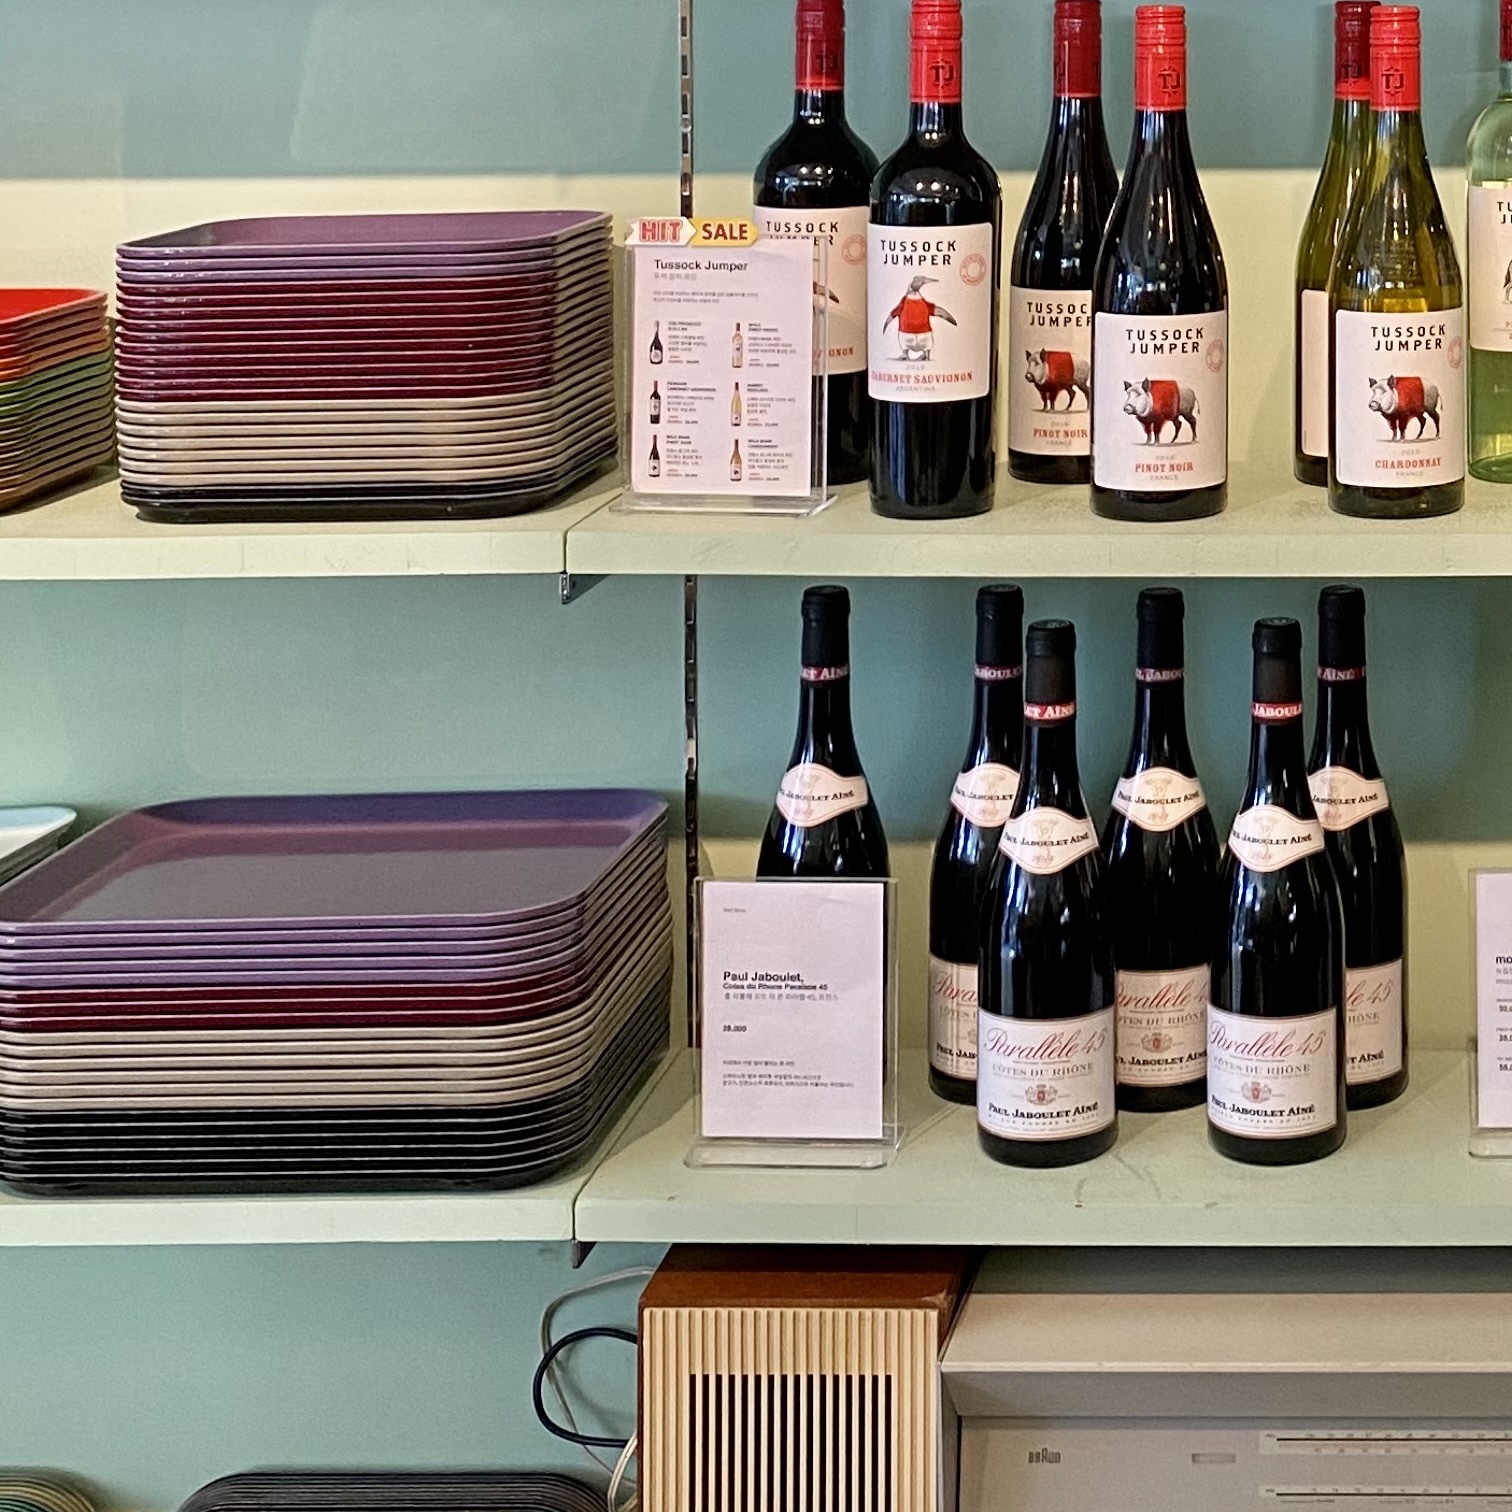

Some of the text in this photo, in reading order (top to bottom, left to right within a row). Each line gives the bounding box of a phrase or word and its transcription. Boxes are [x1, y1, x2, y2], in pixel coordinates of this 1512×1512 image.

[929, 64, 954, 82] TJ
[1158, 71, 1180, 90] TJ
[1381, 73, 1404, 89] TJ
[640, 221, 682, 242] HIT
[702, 223, 748, 240] SALE
[767, 221, 838, 233] TUSSOCK
[880, 240, 956, 252] TUSSOCK
[654, 259, 748, 273] Tussock Jumper
[884, 254, 951, 266] JUMPER
[1027, 302, 1088, 314] TUSSOC
[1126, 328, 1203, 340] TUSSOCK
[1371, 324, 1446, 337] TUSSOCK
[1130, 342, 1200, 354] JUMPER
[1375, 339, 1442, 351] JUMPER
[871, 372, 972, 383] CABERNET SAUVIGNON
[1033, 429, 1088, 438] PINOT NOIR
[1135, 462, 1193, 472] PINOT NOIR
[1375, 457, 1441, 469] CHARDONNAY
[1135, 796, 1182, 804] JABOULET
[1312, 795, 1356, 804] JABOULET
[1020, 837, 1068, 846] JABOULET
[1242, 835, 1287, 845] JABOULET
[723, 972, 804, 983] Paul Jaboulet,
[1367, 980, 1393, 1004] 45
[1082, 1028, 1107, 1055] 45
[1296, 1029, 1326, 1056] 45
[1129, 1056, 1183, 1066] JABOULET
[992, 1061, 1093, 1076] CÔTES DU RHÔNE
[1246, 1063, 1310, 1075] DU RHÔNE
[988, 1101, 1099, 1119] PAUL JABOULET AÎNÉ
[1212, 1094, 1316, 1117] PAUL JABOULET AÎNÉ
[1028, 1448, 1061, 1463] BRAUN
